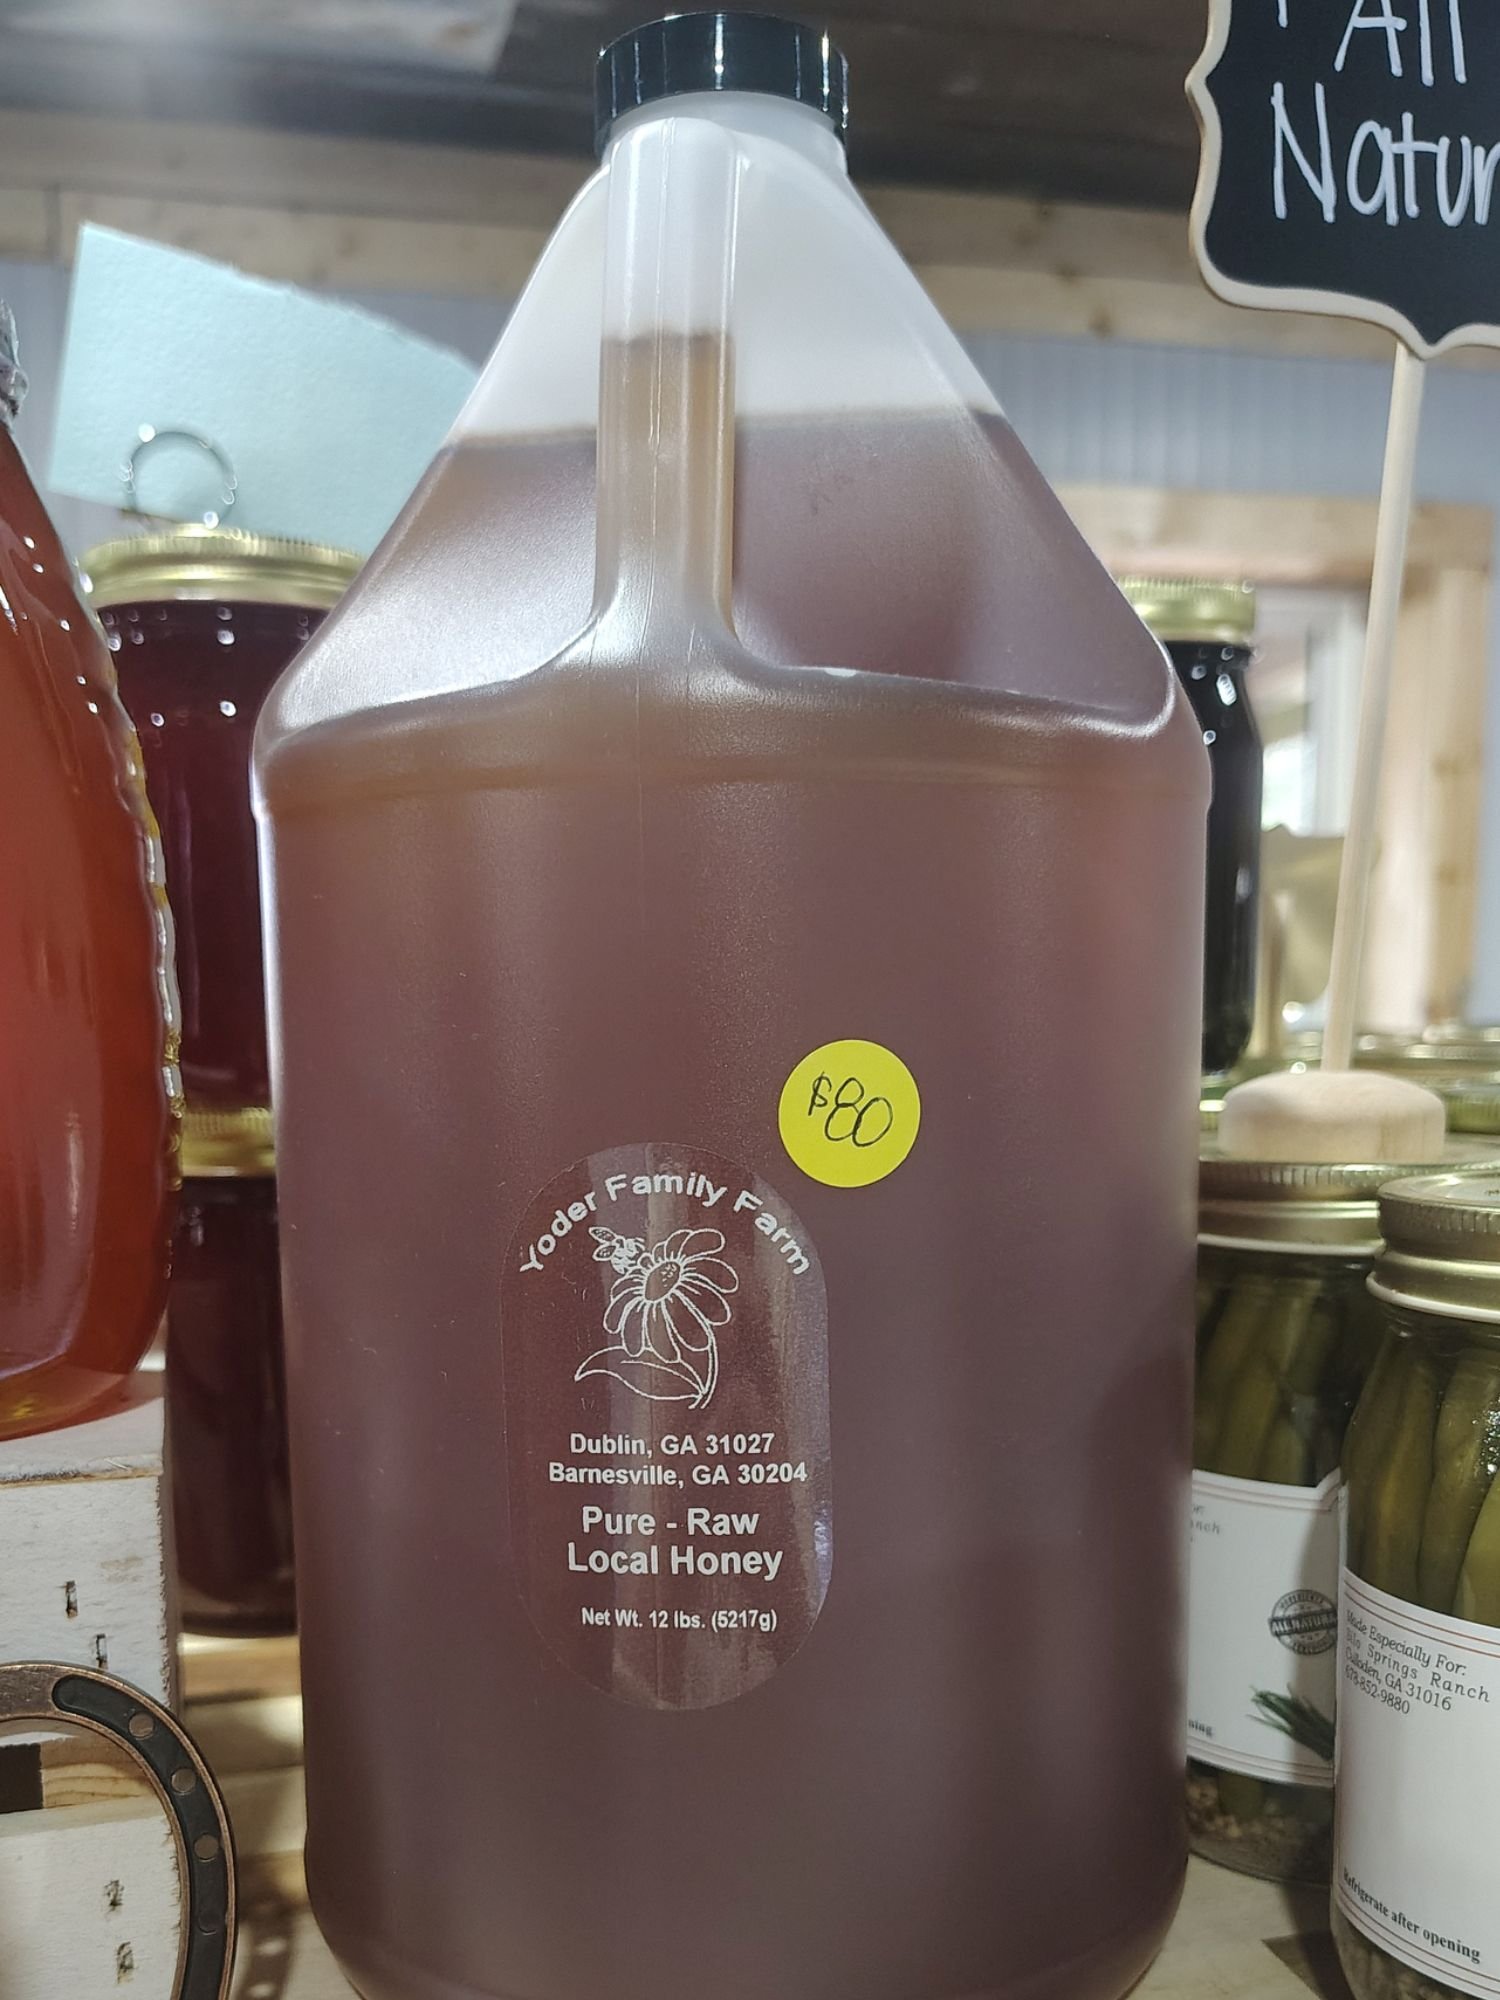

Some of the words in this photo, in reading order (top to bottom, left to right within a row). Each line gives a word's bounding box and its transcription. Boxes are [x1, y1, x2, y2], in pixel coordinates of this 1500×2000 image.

[808, 1071, 893, 1148] $80
[519, 1191, 597, 1273] Yoder
[604, 1172, 728, 1208] Family
[733, 1190, 810, 1275] Farm
[570, 1433, 653, 1458] Dublin,
[660, 1435, 698, 1455] GA
[706, 1433, 775, 1454] 31027
[549, 1462, 685, 1488] Barnesville,
[692, 1465, 730, 1485] GA
[737, 1462, 807, 1484] 30204
[582, 1506, 656, 1535] Pure
[687, 1508, 760, 1536] Raw
[568, 1542, 659, 1574] Local
[671, 1546, 783, 1581] Honey
[581, 1608, 610, 1626] Net
[615, 1609, 643, 1628] Wt.
[649, 1610, 668, 1628] 12
[674, 1611, 706, 1629] lbs.
[712, 1609, 778, 1632] (5217g)
[1369, 1625, 1431, 1668] Especially
[1367, 1643, 1418, 1679] Springs
[1430, 1671, 1490, 1702] Ranch
[1385, 1672, 1402, 1692] GA
[1405, 1682, 1451, 1711] 31016
[1343, 1866, 1389, 1917] Refrigerate
[1391, 1911, 1420, 1934] after
[1423, 1928, 1480, 1964] opening
